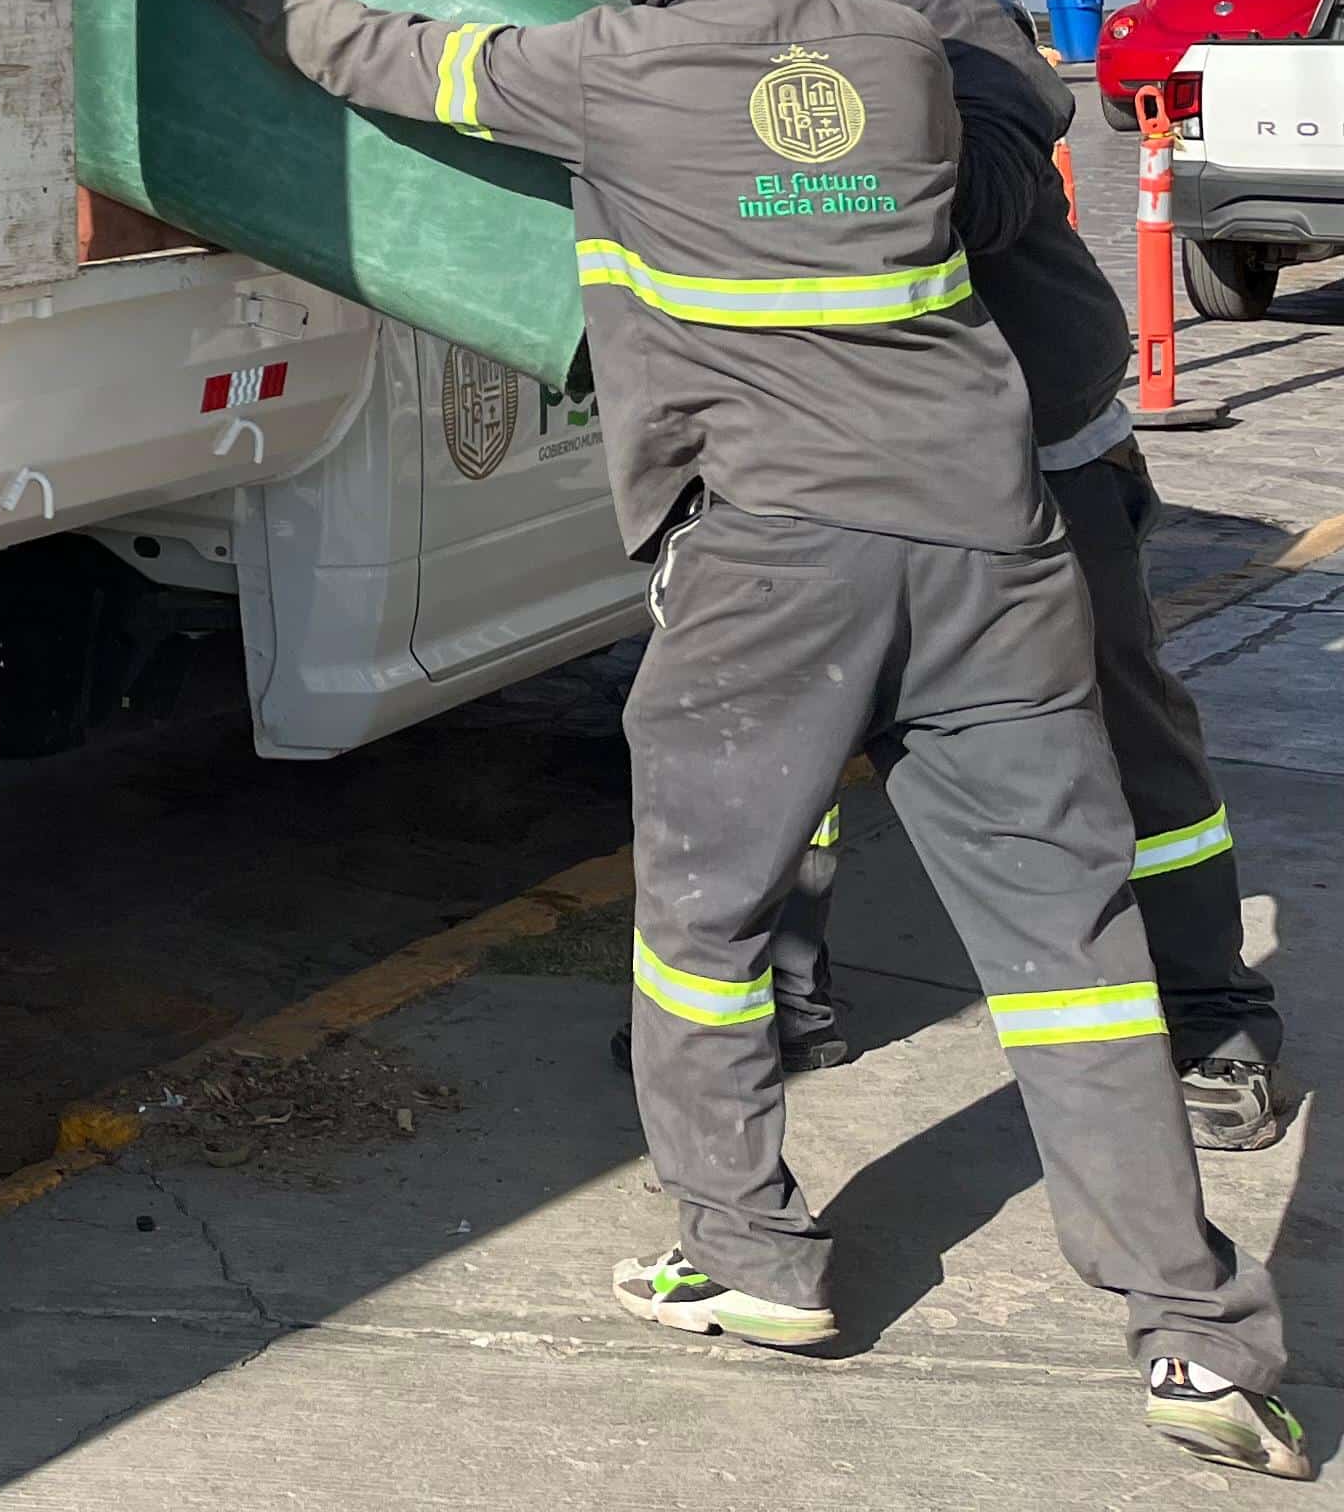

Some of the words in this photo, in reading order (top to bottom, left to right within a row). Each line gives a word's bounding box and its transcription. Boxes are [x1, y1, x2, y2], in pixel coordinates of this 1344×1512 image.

[1257, 120, 1344, 137] RO
[755, 174, 786, 196] El
[791, 172, 878, 196] futuro
[738, 194, 814, 218] inicia
[822, 192, 898, 214] ahora
